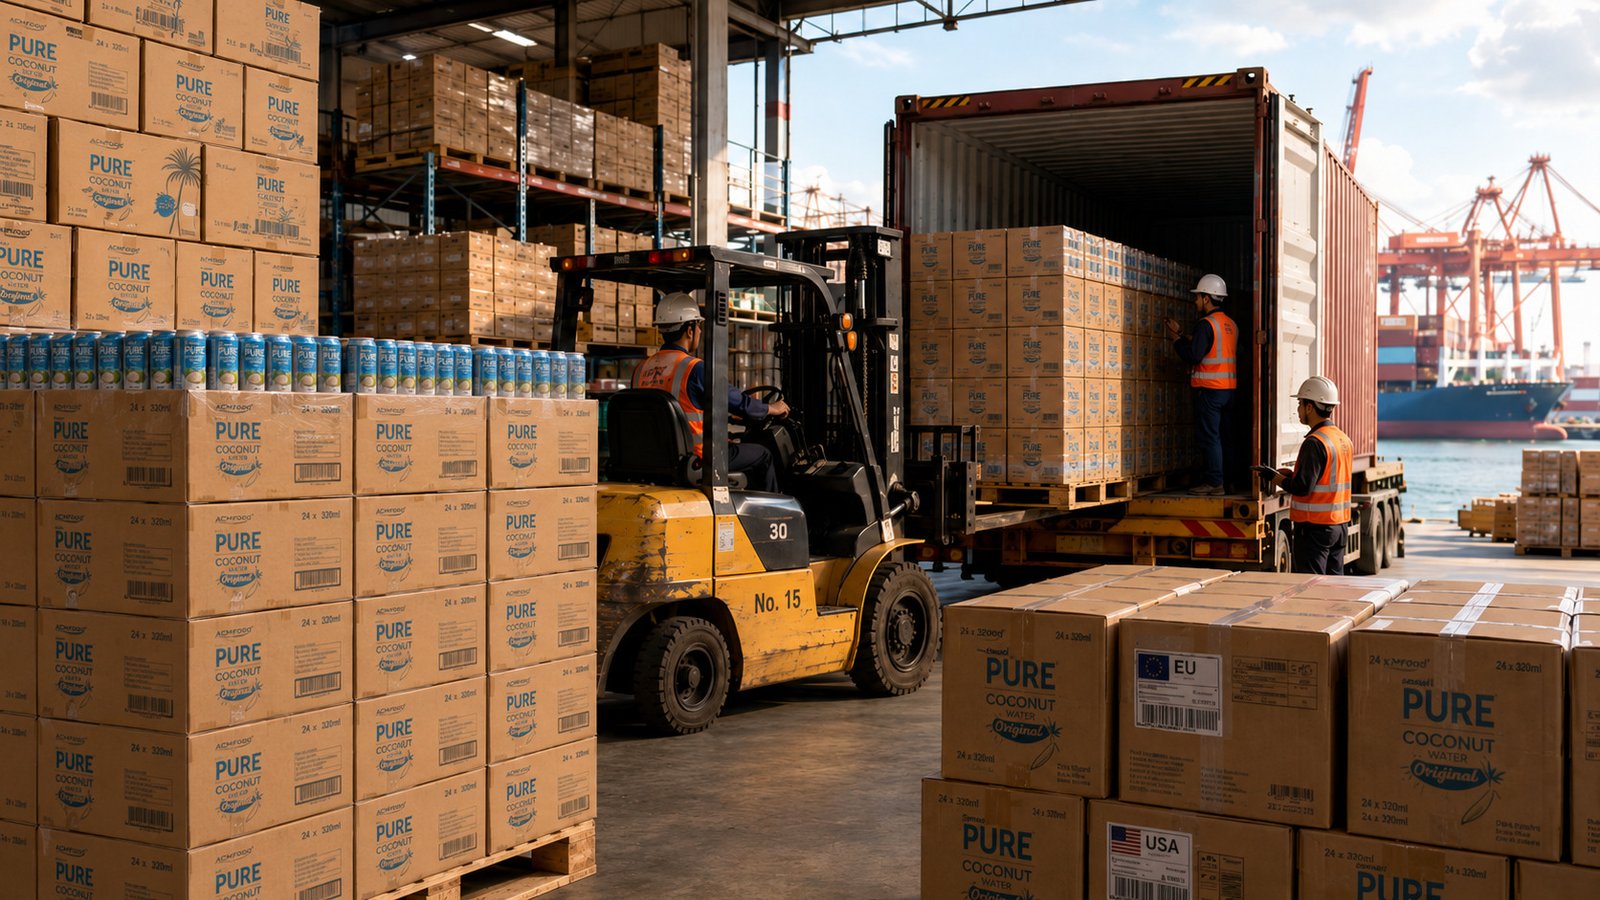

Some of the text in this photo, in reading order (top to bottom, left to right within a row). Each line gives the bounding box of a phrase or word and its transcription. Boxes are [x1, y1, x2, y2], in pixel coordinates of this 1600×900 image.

[265, 6, 290, 24] PURE
[9, 34, 57, 61] PURE
[8, 57, 56, 73] COCONUT
[176, 74, 212, 96] PURE
[268, 96, 299, 115] PURE
[90, 154, 132, 177] PURE
[89, 176, 131, 189] COCONUT
[257, 177, 285, 193] PURE
[109, 260, 150, 280] PURE
[108, 282, 150, 293] COCONUT
[201, 271, 234, 288] PURE
[273, 278, 300, 292] PURE
[54, 422, 88, 439] PURE
[216, 422, 261, 440] PURE
[377, 424, 412, 440] PURE
[508, 424, 536, 439] PURE
[216, 445, 260, 454] COCONUT
[376, 444, 411, 452] COCONUT
[302, 512, 309, 520] 24
[506, 514, 536, 530] PURE
[376, 522, 412, 540] PURE
[770, 523, 787, 539] 30
[55, 530, 91, 550] PURE
[216, 531, 261, 552] PURE
[376, 543, 412, 553] COCONUT
[215, 555, 260, 567] COCONUT
[755, 589, 800, 613] No. 15
[506, 602, 536, 620] PURE
[302, 619, 309, 627] 24
[376, 621, 412, 641] PURE
[56, 640, 93, 662] PURE
[216, 643, 262, 667] PURE
[376, 641, 412, 654] COCONUT
[215, 666, 261, 681] COCONUT
[987, 658, 1055, 690] PURE
[1174, 660, 1196, 675] EU
[1496, 662, 1506, 670] 24
[1515, 662, 1542, 673] 320ml
[507, 690, 536, 711] PURE
[986, 694, 1055, 711] COCONUT
[1403, 688, 1494, 727] PURE
[1006, 711, 1035, 721] WATER
[376, 719, 412, 741] PURE
[996, 722, 1044, 737] Original
[376, 739, 412, 754] COCONUT
[1403, 731, 1494, 753] COCONUT
[957, 751, 965, 759] 24
[1428, 751, 1467, 762] WATER
[56, 754, 93, 774] PURE
[215, 752, 262, 780] PURE
[1414, 762, 1479, 783] Original
[215, 776, 261, 795] COCONUT
[507, 778, 536, 800] PURE
[939, 794, 947, 802] 24
[957, 796, 979, 807] 320ml
[1382, 800, 1408, 812] 320ml
[1033, 808, 1040, 816] 24
[376, 816, 412, 842] PURE
[376, 837, 412, 854] COCONUT
[963, 824, 1032, 861] PURE
[1146, 835, 1179, 854] USA
[1325, 849, 1336, 857] 24
[55, 863, 93, 887] PURE
[215, 863, 262, 894] PURE
[963, 861, 1032, 881] COCONUT
[1445, 865, 1455, 875] 24
[1462, 867, 1487, 878] 320ml
[981, 877, 1012, 890] WATER
